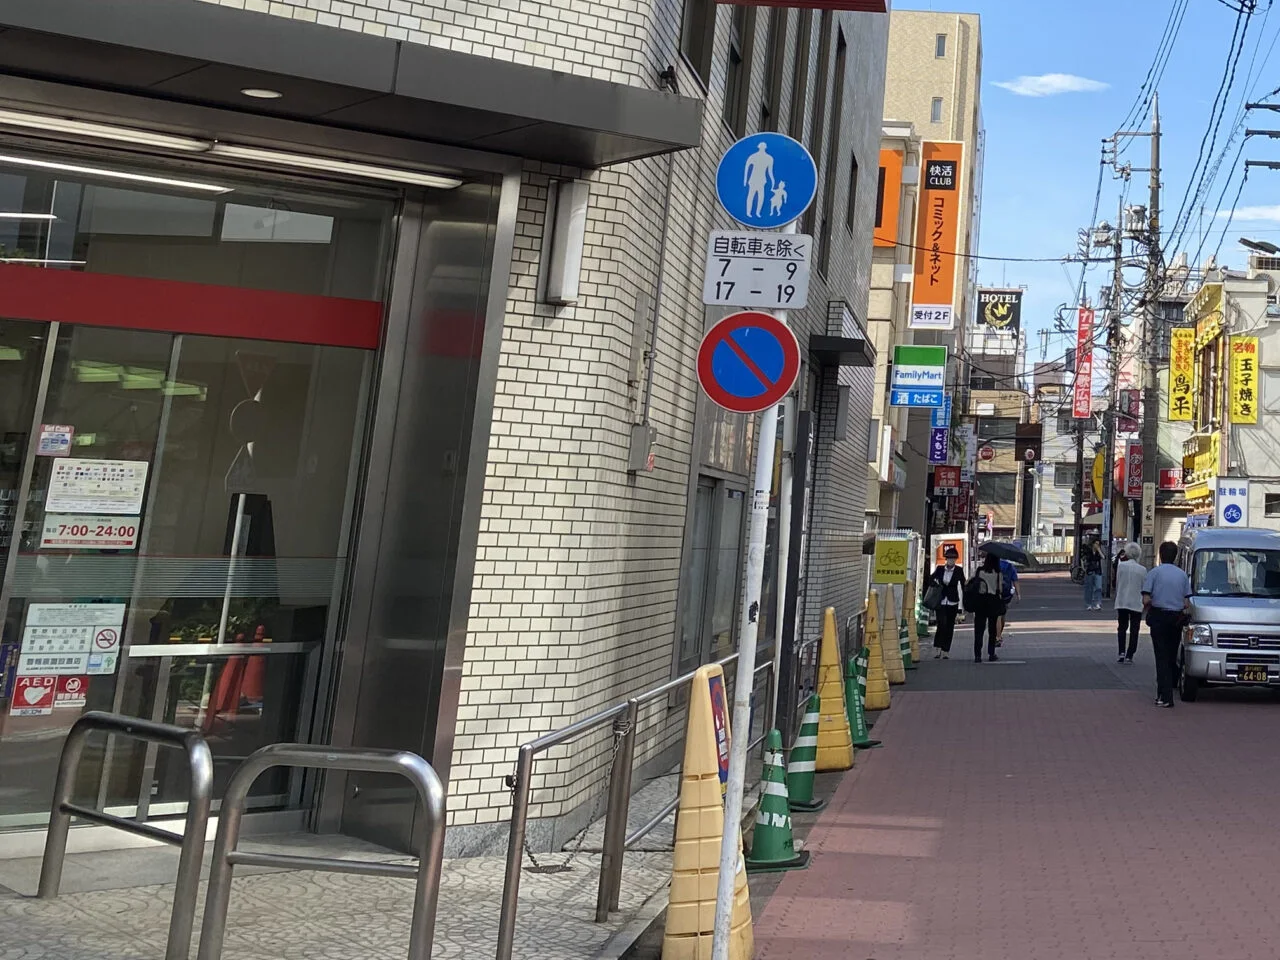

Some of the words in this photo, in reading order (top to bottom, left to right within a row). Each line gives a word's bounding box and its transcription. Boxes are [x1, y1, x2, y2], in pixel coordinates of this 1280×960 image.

[929, 165, 952, 176] 快活
[929, 177, 952, 185] CLUB
[713, 236, 805, 257] 自転車を除く
[930, 197, 944, 286] コミック&ネット
[719, 259, 731, 277] 7
[786, 262, 797, 280] 9
[716, 281, 735, 300] 17
[777, 284, 795, 303] 19
[980, 293, 1019, 303] HOTEL
[914, 310, 949, 320] 受付2F
[1233, 342, 1256, 354] 名物
[894, 369, 942, 381] FamilyMart
[1239, 358, 1254, 417] 玉子焼き
[896, 392, 909, 404] 酒
[913, 394, 938, 404] たばこ
[1172, 373, 1191, 416] 鳥平
[934, 432, 942, 459] ともこ
[1218, 487, 1247, 496] 駐輪場
[19, 677, 54, 687] AED
